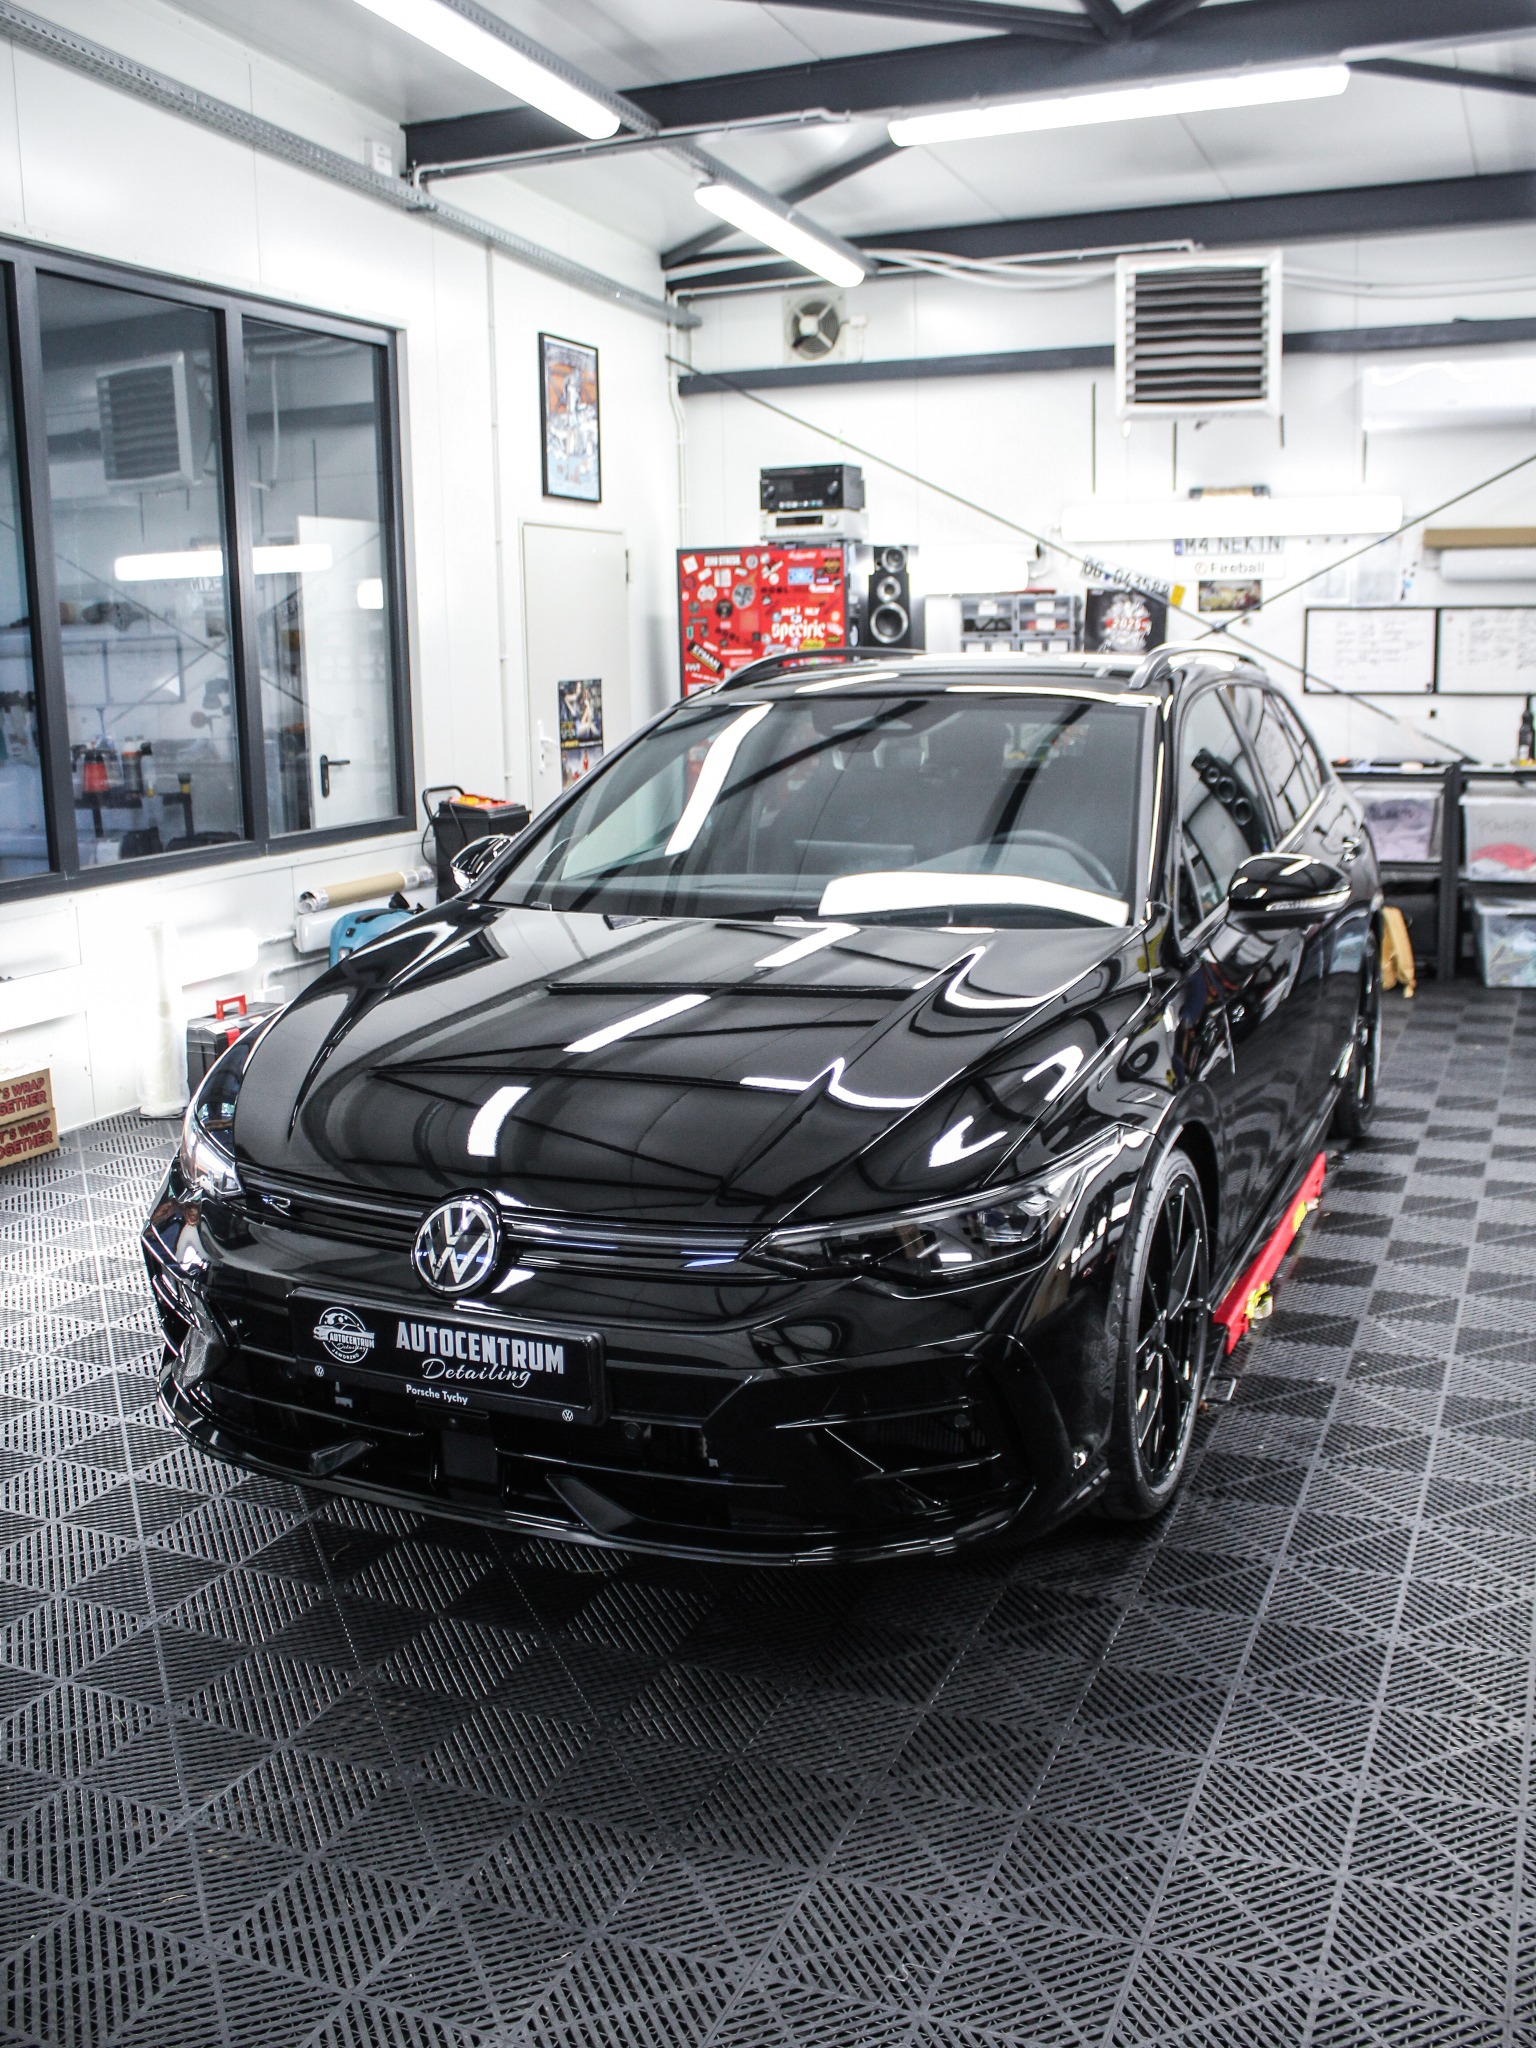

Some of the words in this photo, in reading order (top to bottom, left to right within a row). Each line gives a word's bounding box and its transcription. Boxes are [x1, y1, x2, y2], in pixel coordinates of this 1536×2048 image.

[1210, 561, 1265, 574] Fireball
[11, 1077, 45, 1097] WRAP
[18, 1117, 51, 1137] WRAP
[329, 1332, 375, 1348] AUTOCENTRUM
[396, 1321, 565, 1375] AUTOCENTRUM
[421, 1358, 532, 1389] Detailing
[405, 1384, 440, 1400] Porsche
[442, 1389, 468, 1405] Tychy
